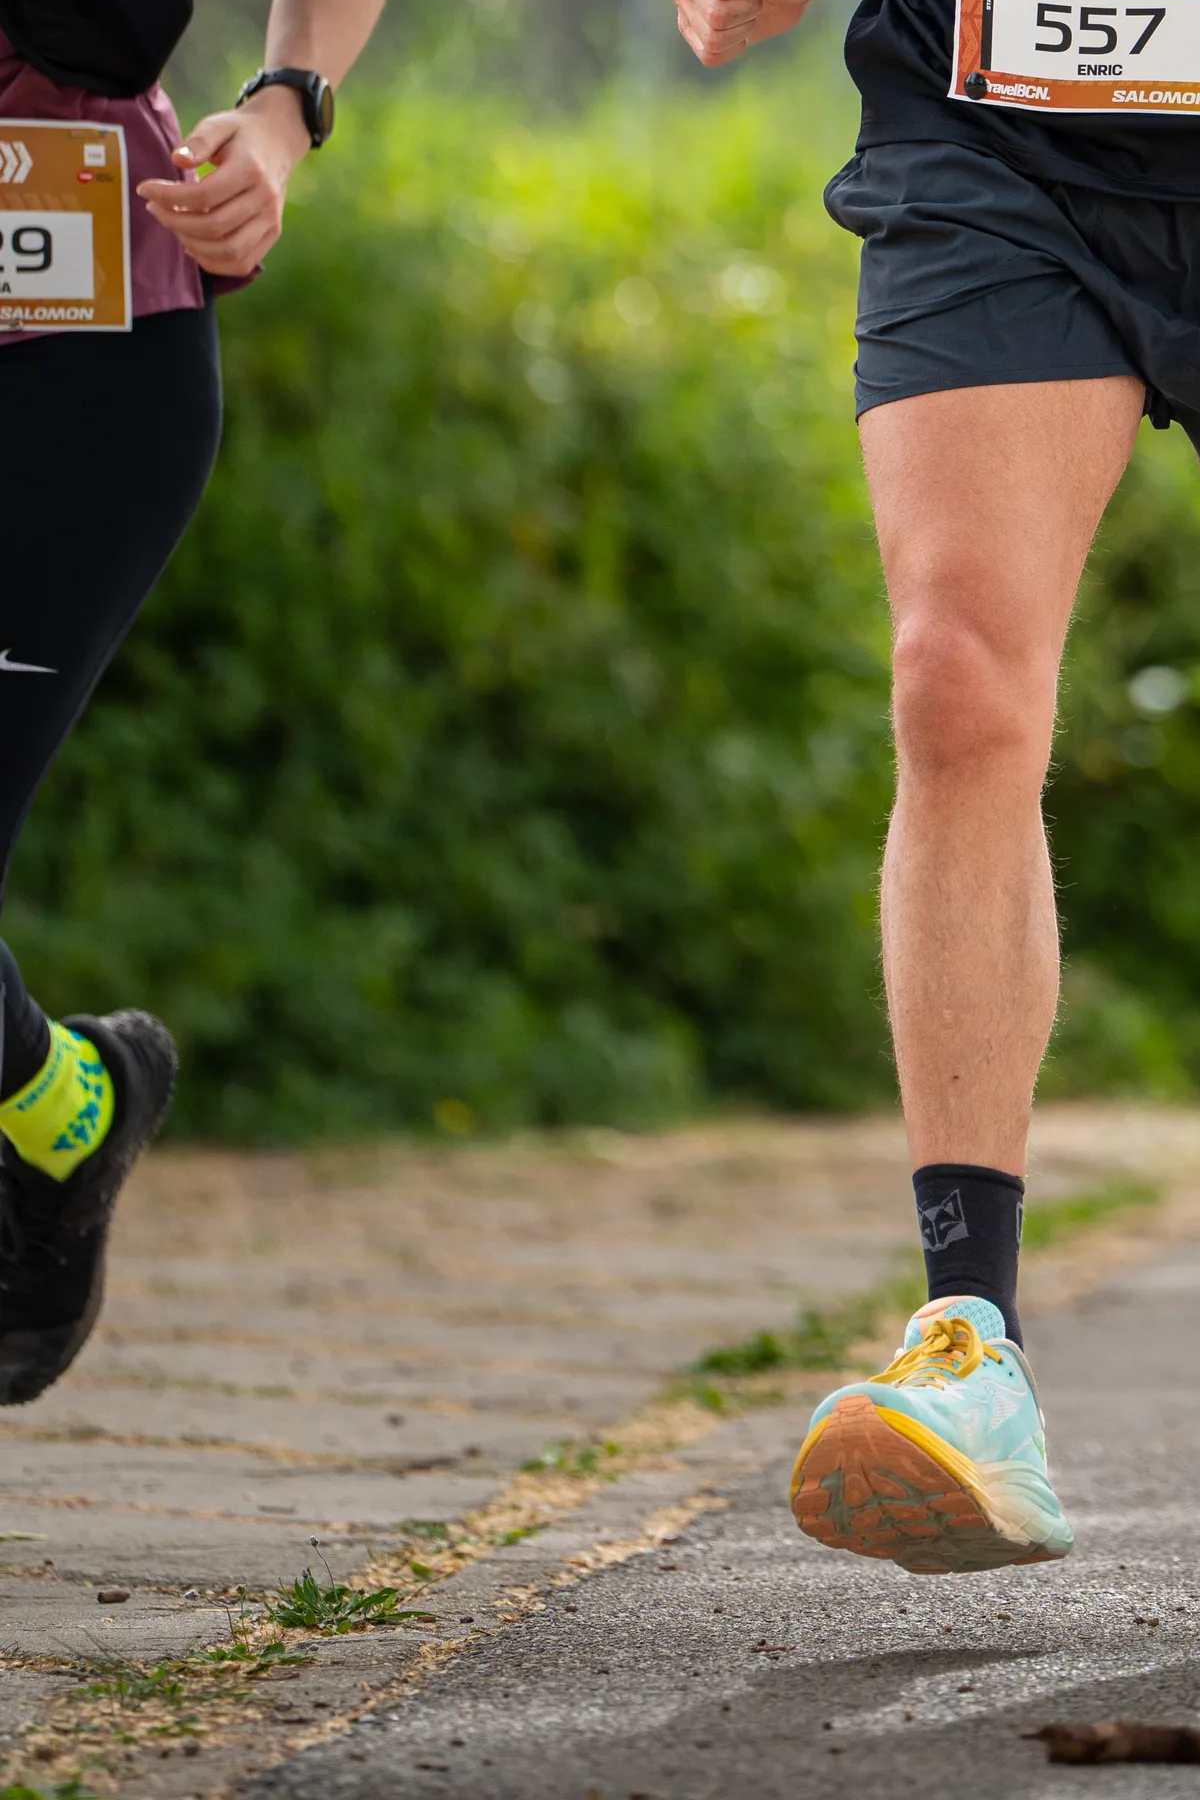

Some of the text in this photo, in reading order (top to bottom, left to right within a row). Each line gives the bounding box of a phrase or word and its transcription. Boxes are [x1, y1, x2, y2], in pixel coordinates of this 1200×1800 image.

[1035, 2, 1166, 55] 557
[1077, 64, 1123, 76] ENRIC
[985, 79, 1051, 101] ravelBCN.
[0, 226, 52, 274] 9
[0, 305, 94, 320] SALOMON
